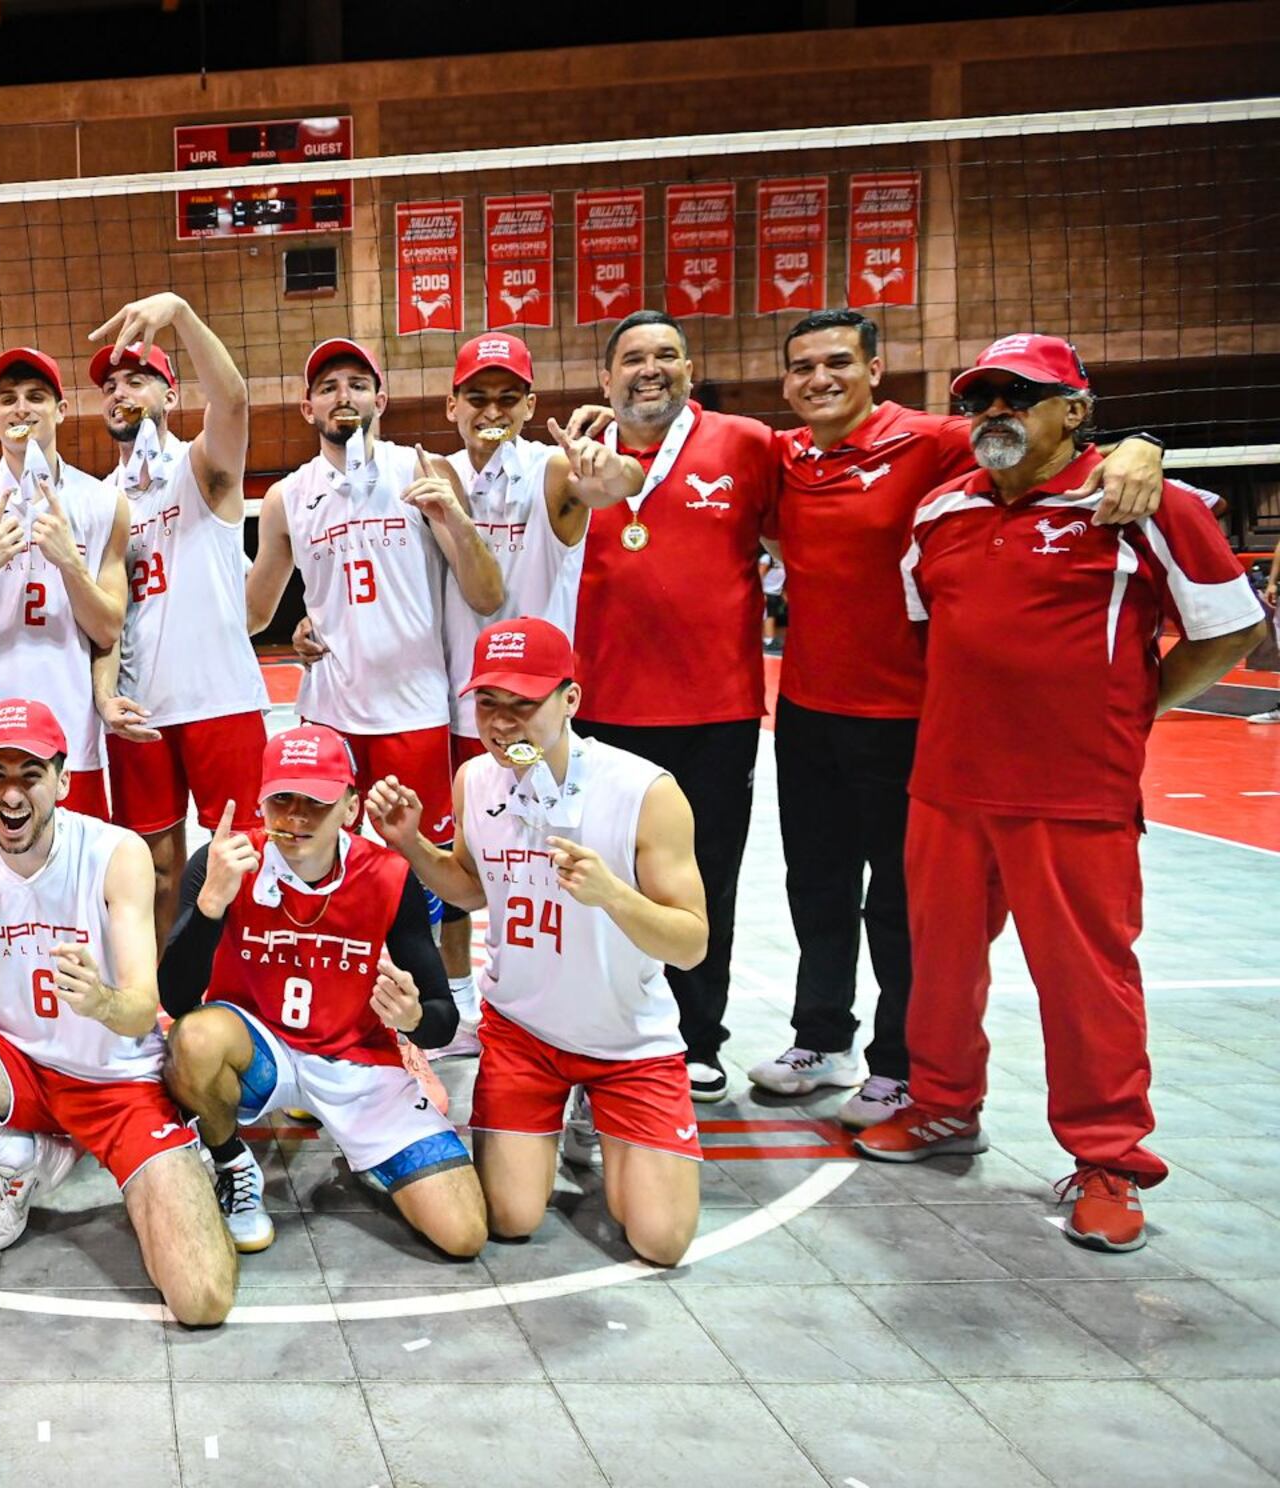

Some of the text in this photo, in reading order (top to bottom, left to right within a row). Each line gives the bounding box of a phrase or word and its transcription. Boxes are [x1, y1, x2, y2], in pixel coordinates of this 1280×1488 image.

[190, 150, 217, 163] UPR
[304, 142, 343, 156] GUEST
[855, 219, 913, 231] CAMPEONES
[491, 240, 548, 252] CAMPEONES
[582, 234, 638, 246] CAMPEONES
[402, 246, 458, 257] CAMPEONES
[865, 247, 902, 266] 2014
[684, 257, 718, 276] 2012
[775, 252, 809, 271] 2013
[503, 268, 536, 286] 2010
[596, 263, 625, 281] 2011
[412, 274, 450, 292] 2009
[310, 518, 406, 545] uprrp
[131, 552, 167, 603] 23
[343, 559, 377, 605] 13
[24, 582, 46, 626] 2
[490, 632, 526, 642] UPR
[283, 740, 318, 750] UPR
[507, 896, 562, 956] 24
[242, 926, 372, 960] uprrp
[241, 950, 368, 975] GALLITOS
[32, 968, 59, 1019] 6
[281, 976, 313, 1030] 8
